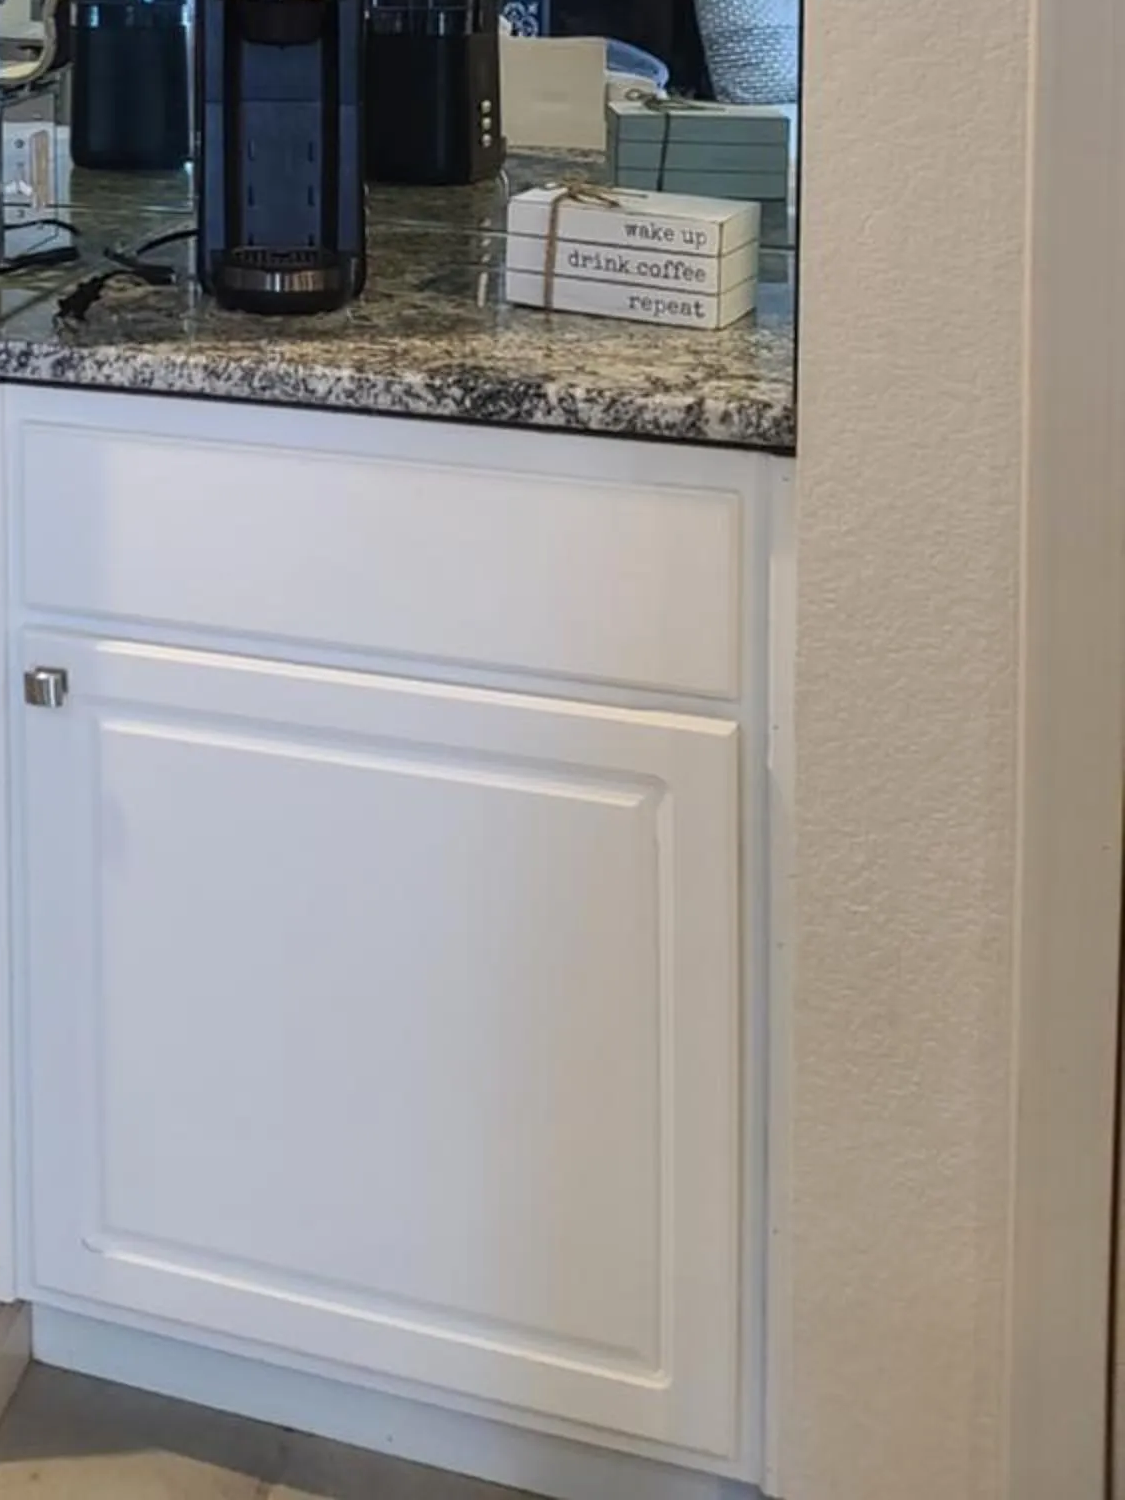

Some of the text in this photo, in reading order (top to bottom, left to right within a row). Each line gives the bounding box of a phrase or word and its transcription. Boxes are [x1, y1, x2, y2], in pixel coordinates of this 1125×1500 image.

[624, 221, 708, 251] wake up
[567, 248, 707, 283] drink coffee
[627, 295, 706, 319] repeat
